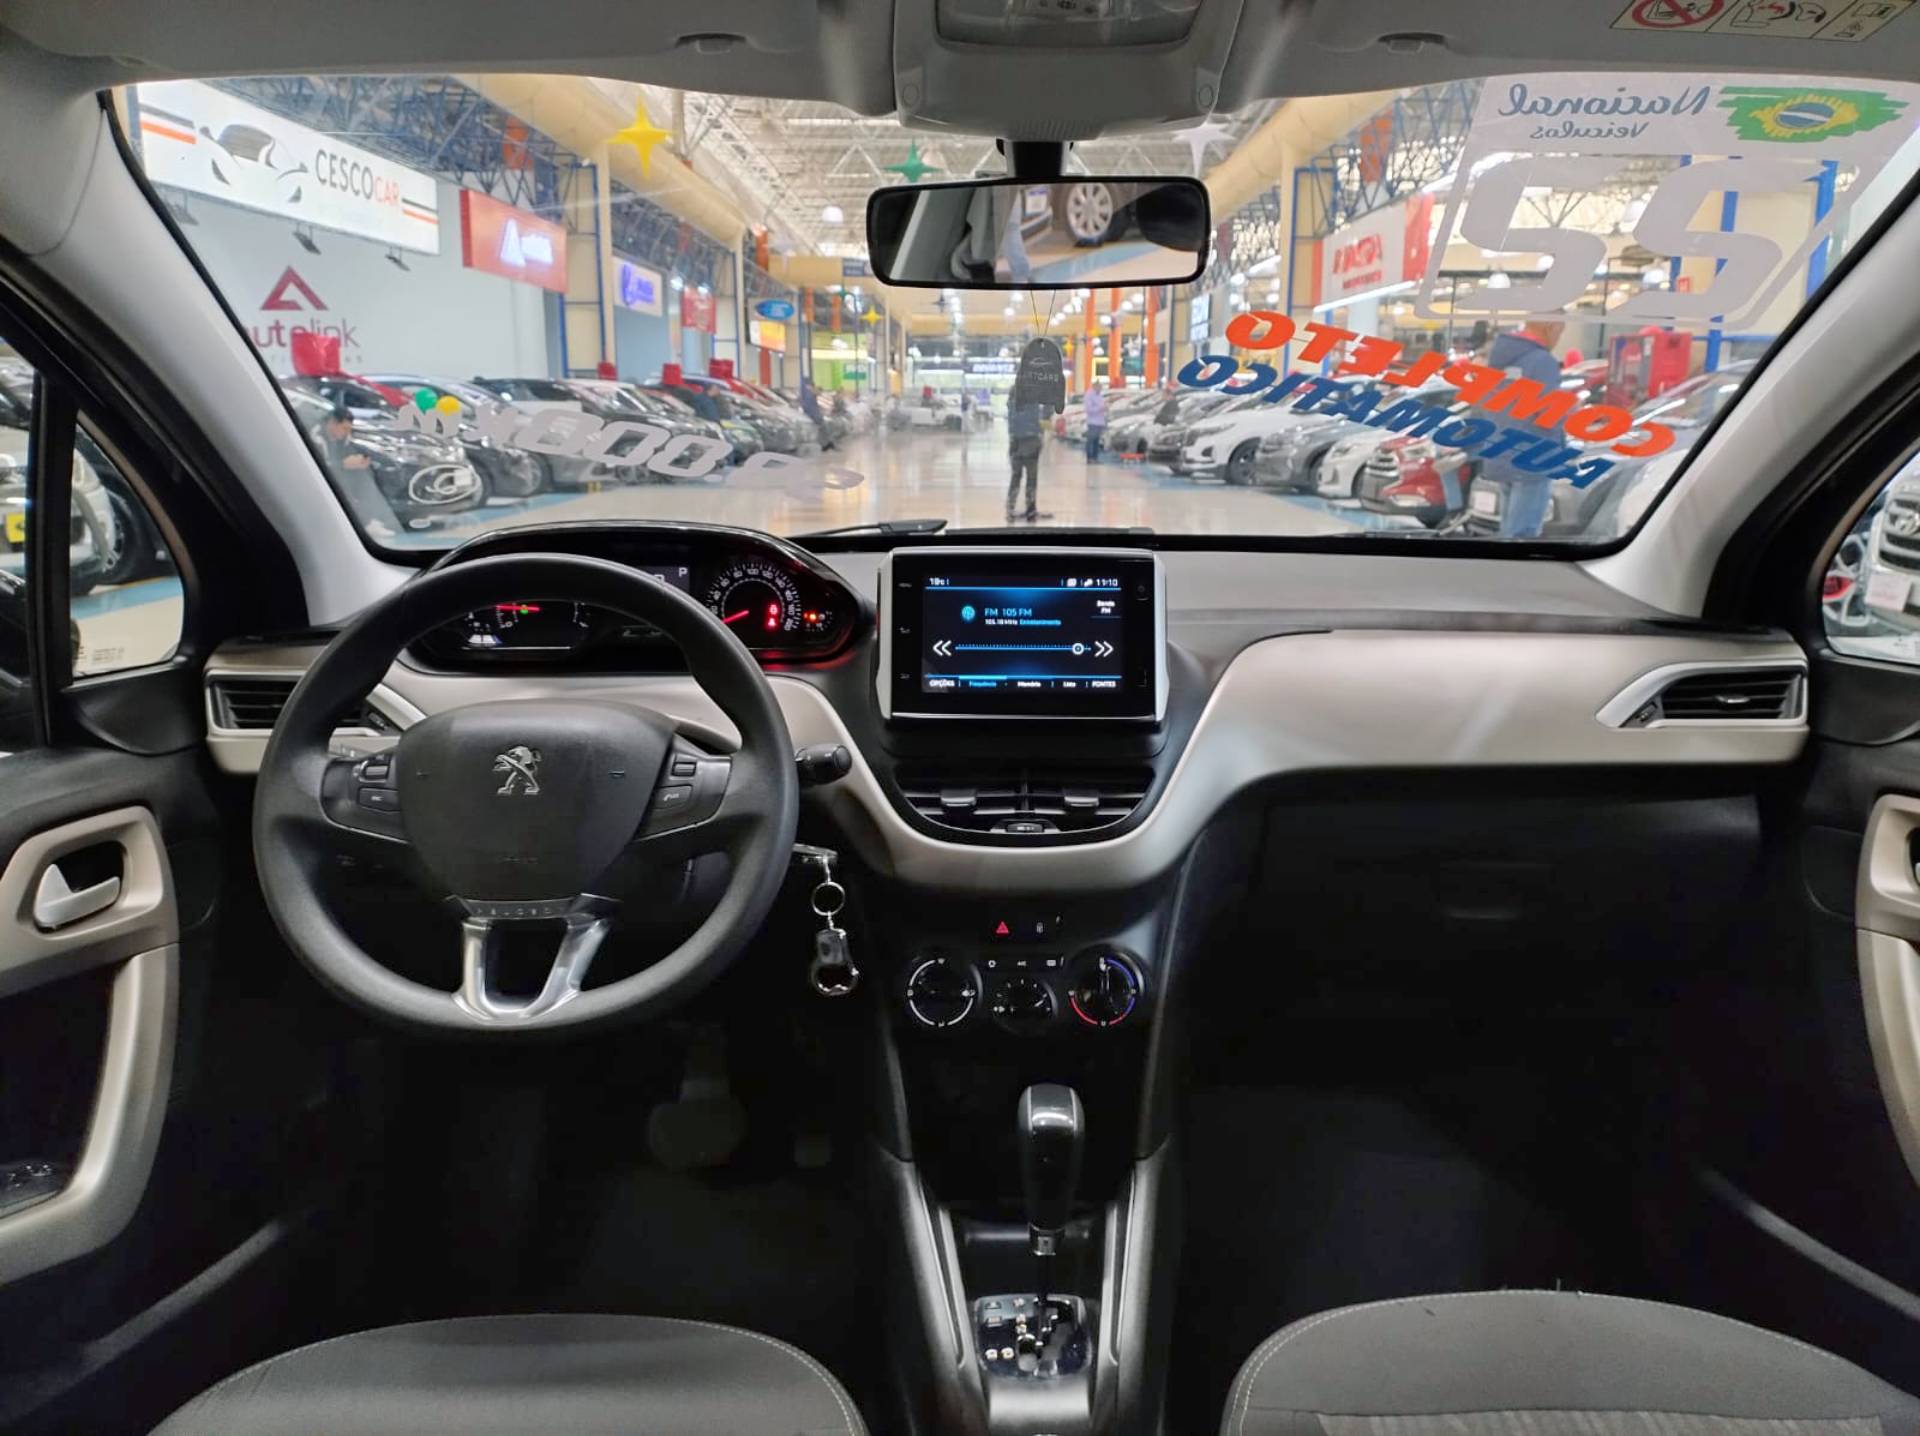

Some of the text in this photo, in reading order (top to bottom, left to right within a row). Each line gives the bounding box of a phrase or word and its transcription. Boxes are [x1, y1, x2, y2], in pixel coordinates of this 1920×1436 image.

[984, 607, 1033, 617] FM 105 FM
